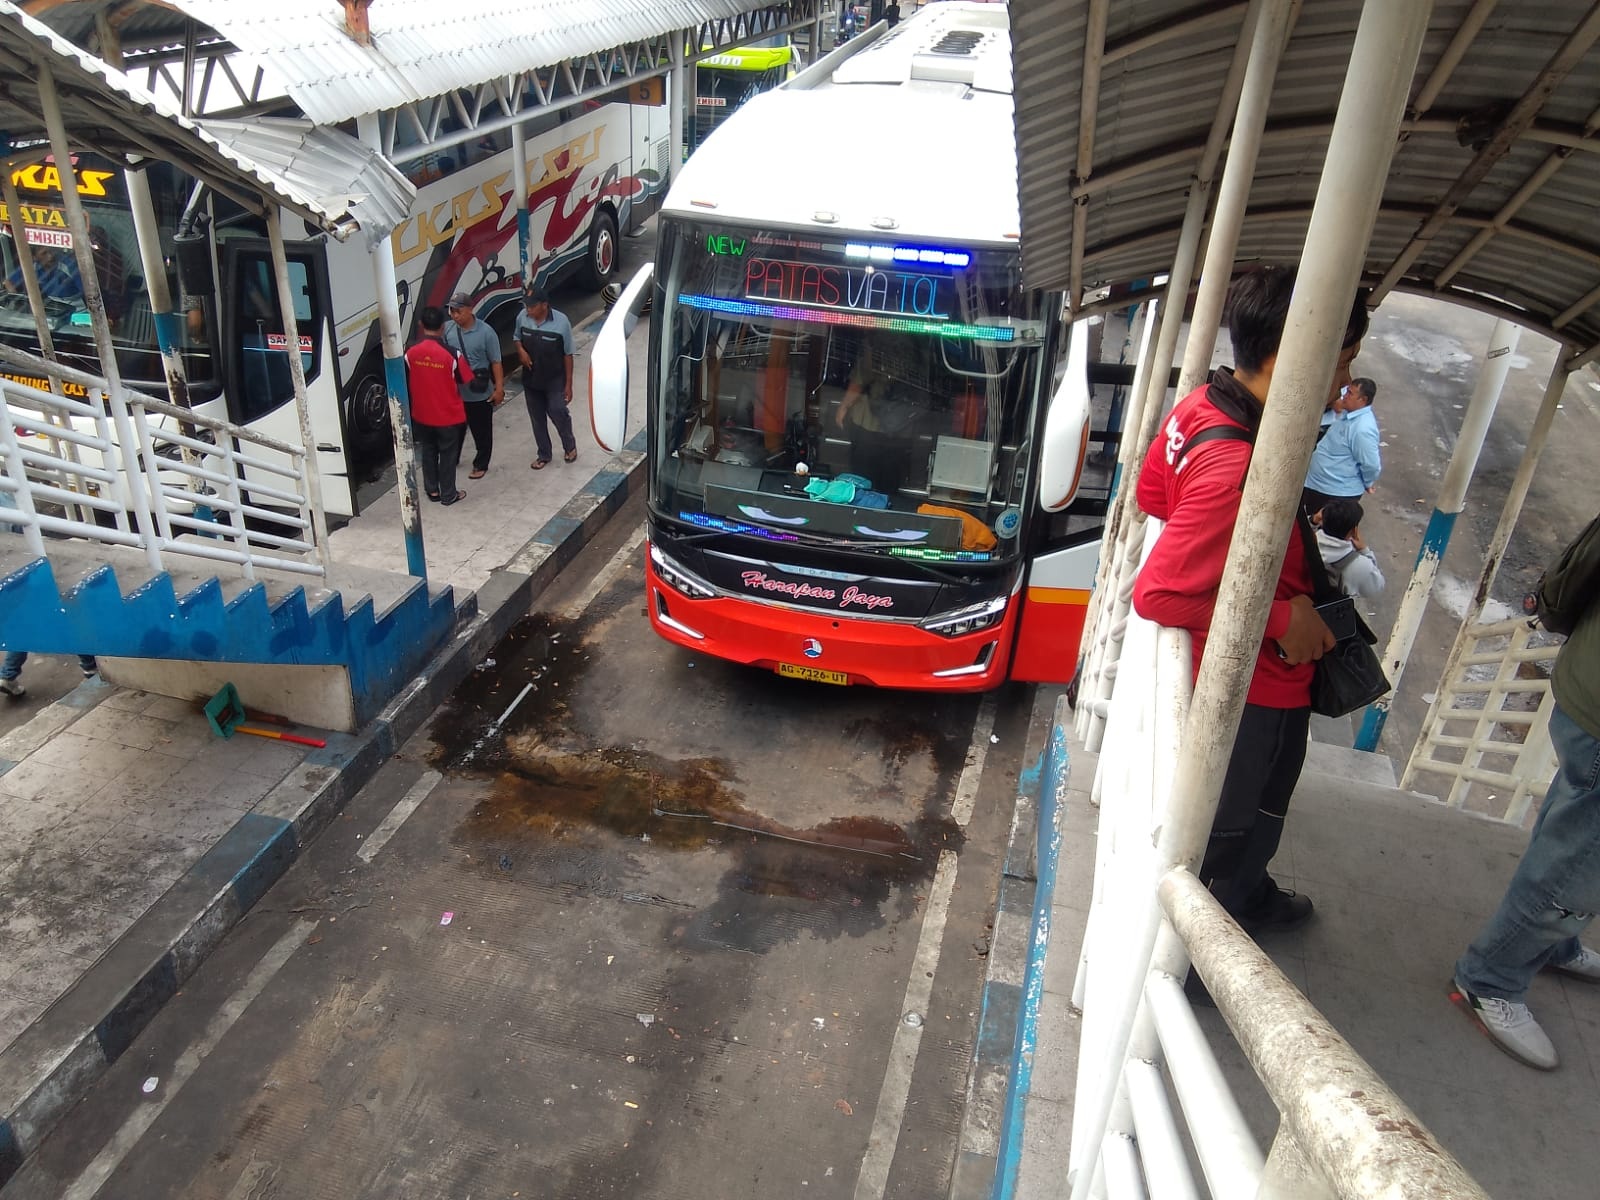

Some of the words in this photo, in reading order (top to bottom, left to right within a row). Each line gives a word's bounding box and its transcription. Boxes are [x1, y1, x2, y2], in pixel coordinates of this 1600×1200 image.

[9, 163, 115, 196] KAS
[0, 204, 70, 228] PATA
[26, 230, 70, 246] EMBER
[707, 233, 746, 256] NEW
[745, 258, 840, 306] PATAS
[847, 269, 888, 311] VIA
[896, 274, 949, 317] TOL
[741, 570, 836, 598] Harapan
[839, 585, 894, 610] Jaya
[781, 664, 794, 674] AG
[832, 673, 846, 683] UT
